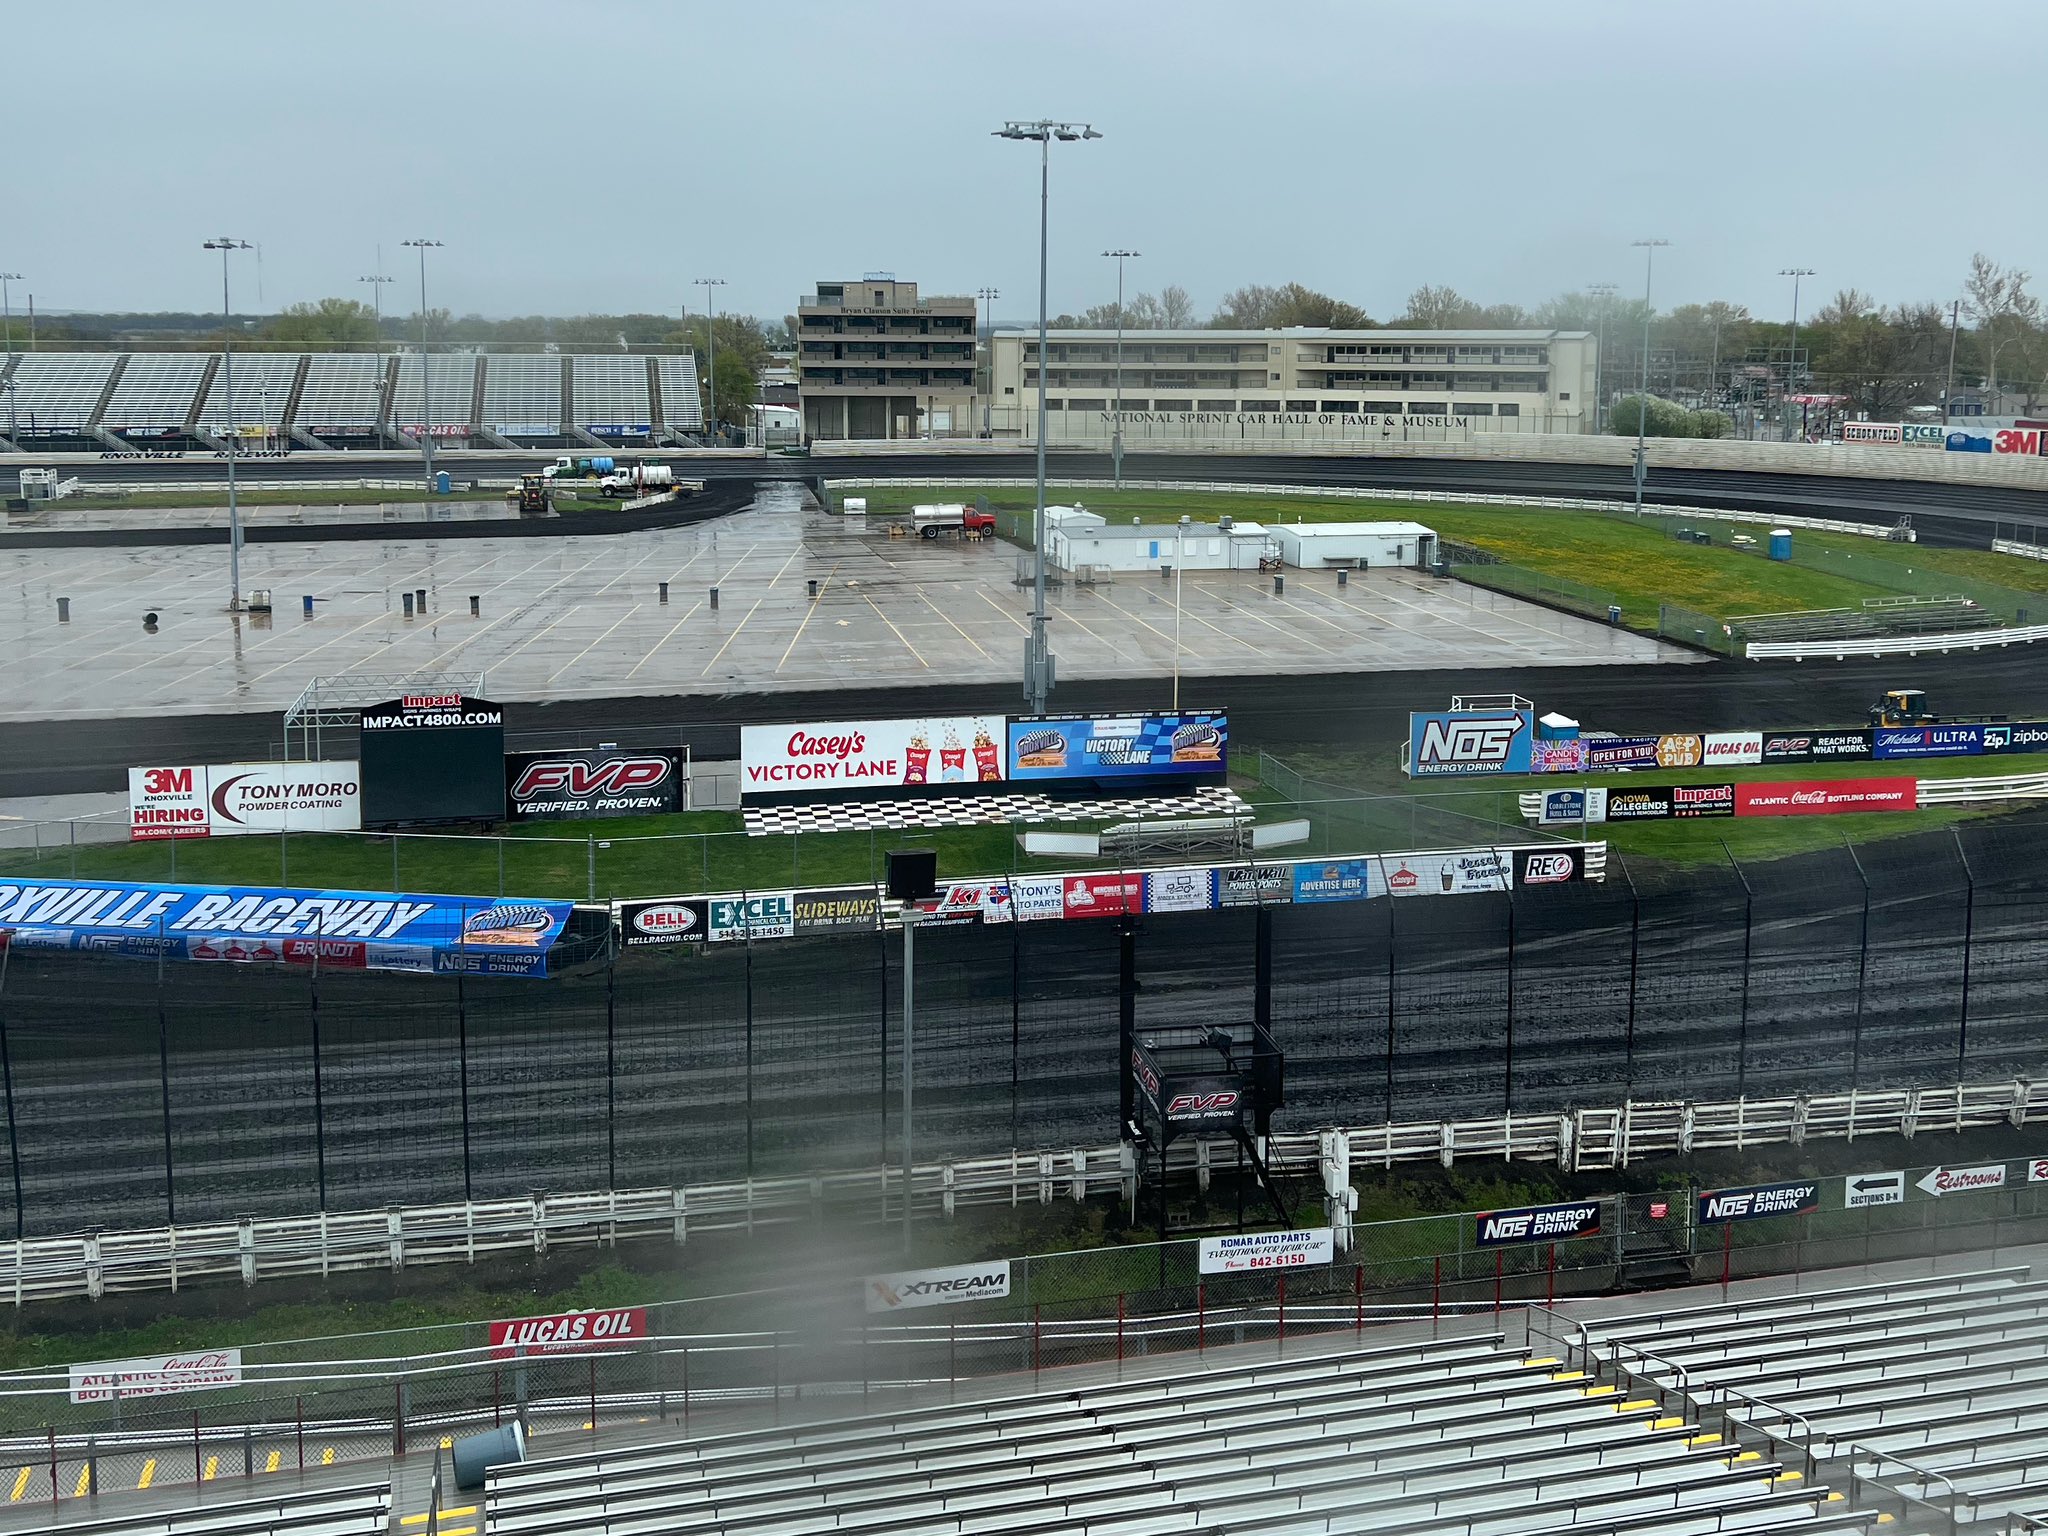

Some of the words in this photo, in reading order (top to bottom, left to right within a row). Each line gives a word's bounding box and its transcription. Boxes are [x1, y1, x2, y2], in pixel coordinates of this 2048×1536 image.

[840, 307, 862, 316] Bryan
[1100, 412, 1174, 423] NATIONAL
[1179, 413, 1232, 424] SPRINT
[1237, 413, 1266, 424] CAR
[1272, 414, 1312, 424] HALL
[1318, 414, 1336, 424] OF
[1341, 415, 1378, 426] FAME
[1384, 415, 1396, 426] &
[1402, 416, 1467, 427] MUSEUM
[450, 425, 466, 434] OIL
[1846, 427, 1898, 440] SCHOENFELD
[1902, 425, 1945, 442] EXCEL
[1995, 429, 2038, 454] 3M
[402, 694, 462, 708] Impact
[363, 712, 501, 728] IMPACT4800.COM
[788, 731, 865, 759] Casey's
[1018, 733, 1059, 758] KNOXVILLE
[1085, 737, 1134, 753] VICTORY
[1419, 715, 1519, 762] NOS
[1664, 737, 1696, 751] A&P
[1765, 737, 1811, 750] FVP
[1818, 737, 1846, 746] REACH
[1847, 736, 1863, 744] FOR
[1877, 732, 1923, 746] Michelob
[1933, 731, 1978, 742] ULTRA
[1983, 733, 2007, 748] Zip.
[1545, 749, 1579, 758] CANDI'S
[1593, 751, 1615, 762] OPEN
[1617, 749, 1632, 759] FOR
[1635, 746, 1653, 756] YOU!
[1706, 742, 1742, 756] LUCAS
[1743, 741, 1759, 754] OIL
[1812, 745, 1836, 754] WHAT
[1123, 751, 1150, 764] LANE
[1664, 752, 1694, 766] PUB
[747, 762, 840, 782] VICTORY
[845, 759, 897, 777] LANE
[1417, 763, 1465, 773] ENERGY
[1466, 762, 1504, 772] DRINK
[144, 768, 192, 793] 3M
[512, 757, 669, 799] FVP
[238, 784, 296, 799] TONY
[297, 782, 357, 797] MORO
[1623, 794, 1650, 802] IOWA
[1673, 785, 1732, 804] Impact
[1749, 797, 1788, 805] ATLANTIC
[1791, 791, 1828, 805] Coca-Cola
[1865, 792, 1903, 800] COMPANY
[238, 801, 288, 811] POWDER
[290, 799, 342, 809] COATING
[516, 800, 590, 814] VERIFIED.
[594, 797, 662, 810] PROVEN.
[1548, 802, 1581, 810] COBBLESTONE
[1623, 801, 1668, 810] LEGENDS
[133, 808, 204, 823] HIRING
[1300, 880, 1340, 891] ADVERTISE
[1342, 878, 1361, 888] HERE
[1391, 875, 1415, 885] Casey's
[948, 886, 983, 905] K1
[1021, 885, 1061, 896] TONY'S
[794, 899, 876, 918] SLIDEWAYS
[1033, 899, 1062, 907] PARTS
[169, 894, 434, 939] RACEWAY
[464, 909, 548, 932] KNOXVILLE
[643, 913, 687, 926] BELL
[711, 898, 791, 928] EXCEL
[813, 918, 834, 926] DRINK
[627, 933, 703, 945] BELLRACING.COM
[719, 927, 784, 938] 515-28-1450
[127, 937, 180, 947] ENERGY
[289, 941, 360, 957] BRANDT
[488, 954, 540, 964] ENERGY
[488, 963, 528, 973] DRINK
[1166, 1091, 1239, 1113] FVP
[1203, 1110, 1234, 1118] PROVEN.
[1933, 1170, 2002, 1191] Restrooms
[1755, 1186, 1814, 1202] ENERGY
[1850, 1193, 1884, 1205] SECTIONS
[1885, 1191, 1898, 1201] D-N
[1706, 1193, 1754, 1218] NOS
[1753, 1199, 1799, 1213] DRINK
[1535, 1207, 1596, 1224] ENERGY
[1483, 1214, 1533, 1239] NOS
[1532, 1220, 1580, 1234] DRINK
[1220, 1237, 1253, 1248] ROMAR
[1254, 1235, 1279, 1245] AUTO
[1281, 1232, 1311, 1243] PARTS
[1261, 1245, 1279, 1254] FOR
[1280, 1243, 1304, 1253] YOUR
[1250, 1254, 1305, 1268] 842-6150
[903, 1273, 1005, 1296] XTREAM
[965, 1287, 1003, 1298] Mediacom
[502, 1316, 587, 1345] LUCAS
[592, 1312, 632, 1336] OIL
[162, 1354, 230, 1378] Coca-Cola
[78, 1383, 154, 1400] BOTLING
[159, 1375, 234, 1392] COMPANY
